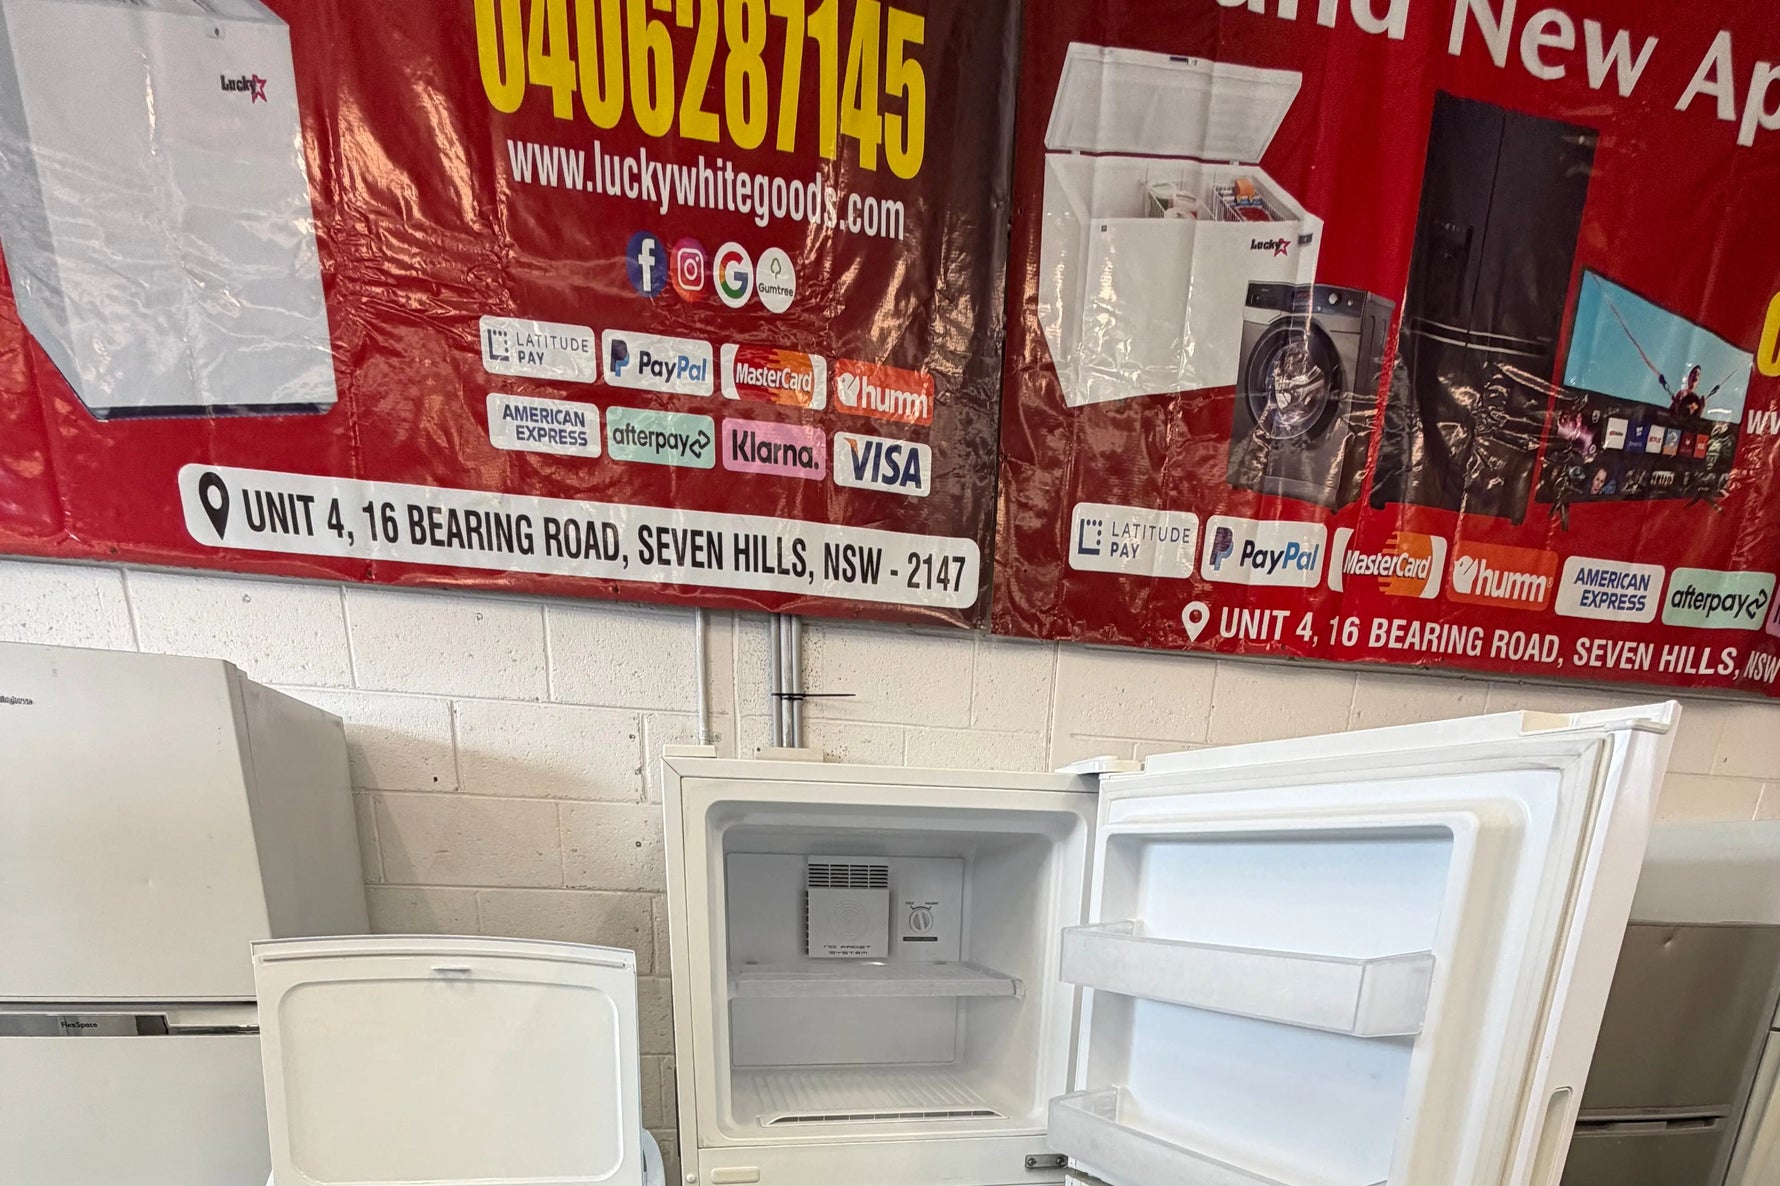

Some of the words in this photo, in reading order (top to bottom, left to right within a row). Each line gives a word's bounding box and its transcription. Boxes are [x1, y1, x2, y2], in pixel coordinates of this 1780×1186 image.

[1448, 0, 1659, 98] New
[220, 74, 256, 96] Lucky
[474, 0, 926, 180] 0406287145
[507, 139, 905, 241] www.luckywhitegoods.com
[1250, 238, 1281, 251] Lucky
[719, 251, 748, 299] G
[758, 282, 794, 297] Gumtree
[516, 331, 589, 353] LATITUDE
[518, 350, 545, 366] PAY
[638, 350, 708, 383] PayPal
[735, 362, 813, 392] MasterCard
[502, 404, 586, 428] AMERICAN
[515, 425, 588, 446] EXPRESS
[612, 423, 690, 457] afterpay
[843, 437, 923, 489] VISA
[241, 488, 315, 537] UNIT
[327, 497, 355, 547] 4,
[362, 500, 399, 544] 16
[406, 503, 535, 555] BEARING
[543, 516, 629, 570] ROAD,
[637, 523, 724, 571] SEVEN
[733, 532, 815, 586] HILLS,
[823, 541, 883, 585] NSW
[906, 551, 966, 593] 2147
[1110, 520, 1191, 544] LATITUDE
[1110, 541, 1140, 559] PAY
[1240, 539, 1320, 575] PayPal
[1343, 549, 1432, 580] MasterCard
[1475, 558, 1548, 603] humm
[1573, 567, 1652, 592] AMERICAN
[1579, 589, 1648, 612] EXPRESS
[1670, 584, 1750, 619] afterpay
[1219, 606, 1291, 641] UNIT
[1295, 611, 1319, 648] 4,
[1329, 615, 1361, 647] 16
[1368, 617, 1485, 657] BEARING
[1490, 629, 1564, 669] ROAD,
[1572, 636, 1655, 672] SEVEN
[1658, 643, 1740, 681] HILLS,
